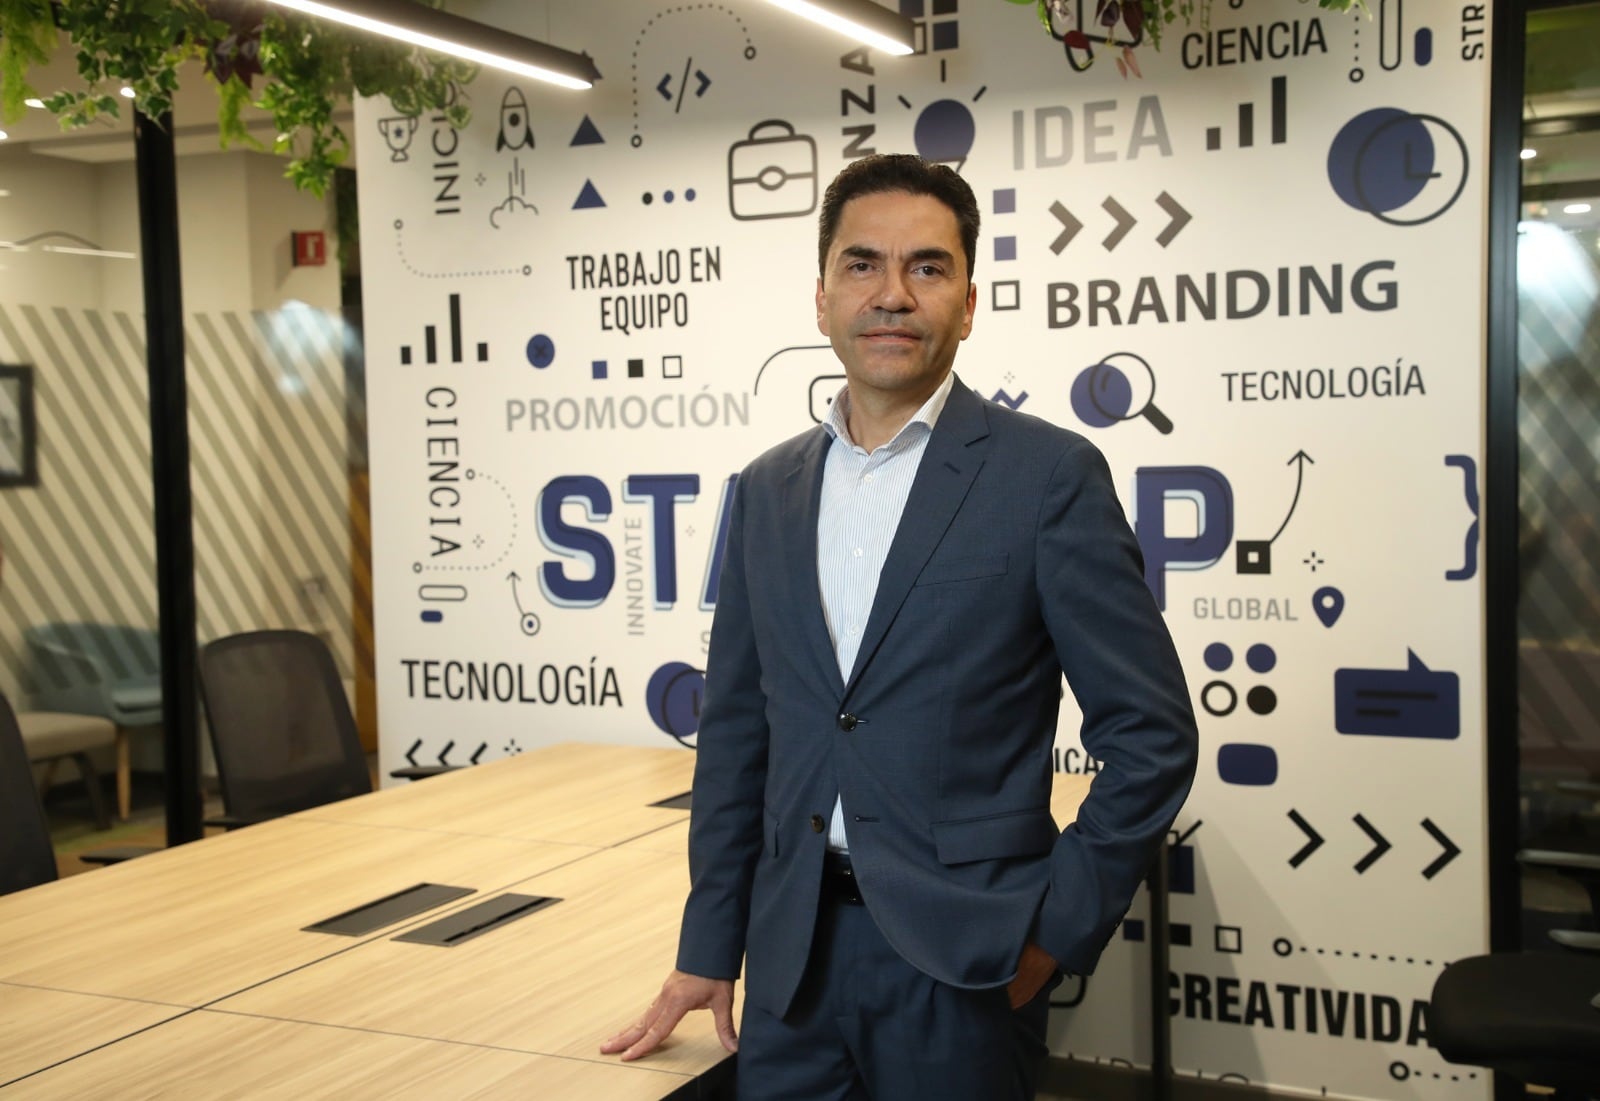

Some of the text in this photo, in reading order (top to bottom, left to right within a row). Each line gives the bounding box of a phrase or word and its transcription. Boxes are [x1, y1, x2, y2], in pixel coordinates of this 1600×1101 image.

[1181, 18, 1328, 70] CIENCIA
[1011, 95, 1174, 171] IDEA
[566, 246, 721, 290] TRABAJO EN
[600, 292, 688, 335] EQUIPO
[1047, 260, 1399, 329] BRANDING
[1221, 358, 1426, 401] TECNOLOGÍA
[505, 384, 751, 432] PROMOCIÓN
[425, 386, 462, 557] CIENCIA
[623, 517, 645, 636] INNOVATE
[1193, 597, 1298, 621] GLOBAL
[401, 656, 623, 708] TECNOLOGÍA
